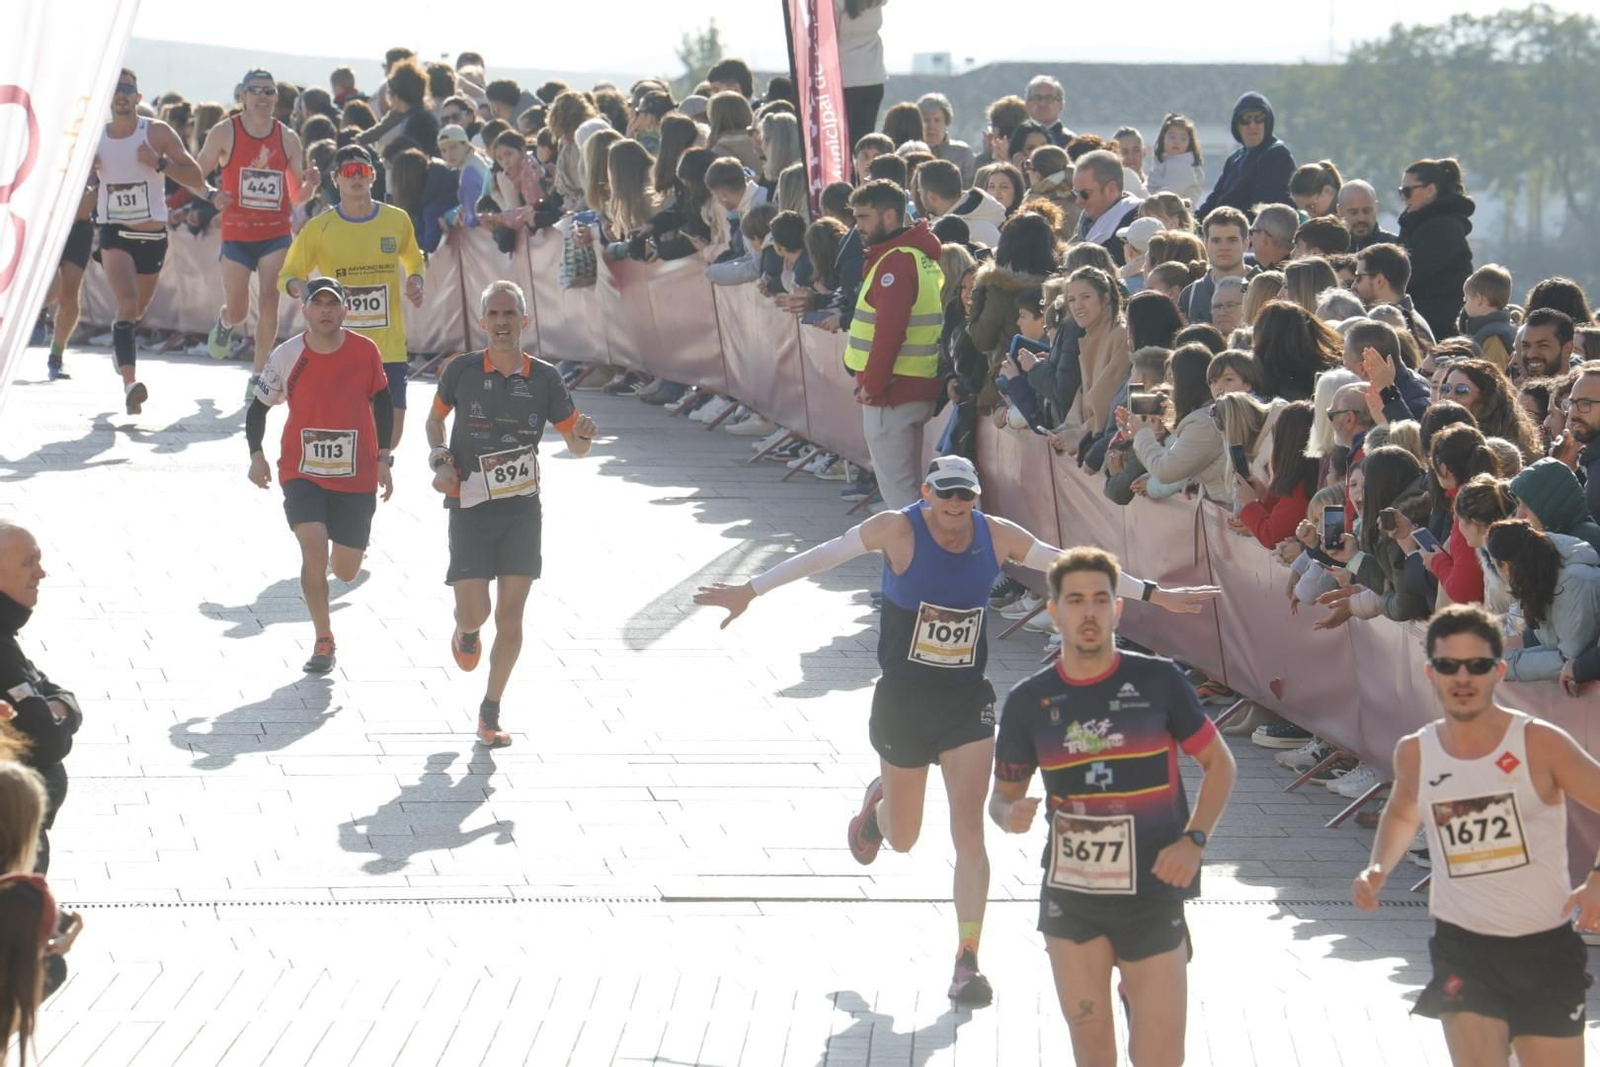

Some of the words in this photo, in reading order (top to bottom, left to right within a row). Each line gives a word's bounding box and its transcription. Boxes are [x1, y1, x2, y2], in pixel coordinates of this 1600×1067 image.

[247, 181, 276, 195] 442
[116, 193, 137, 207] 131
[346, 297, 381, 311] 1910
[312, 442, 344, 460] 1113
[494, 463, 529, 484] 894
[927, 621, 971, 644] 1091
[1445, 816, 1512, 846] 1672
[1062, 837, 1124, 863] 5677
